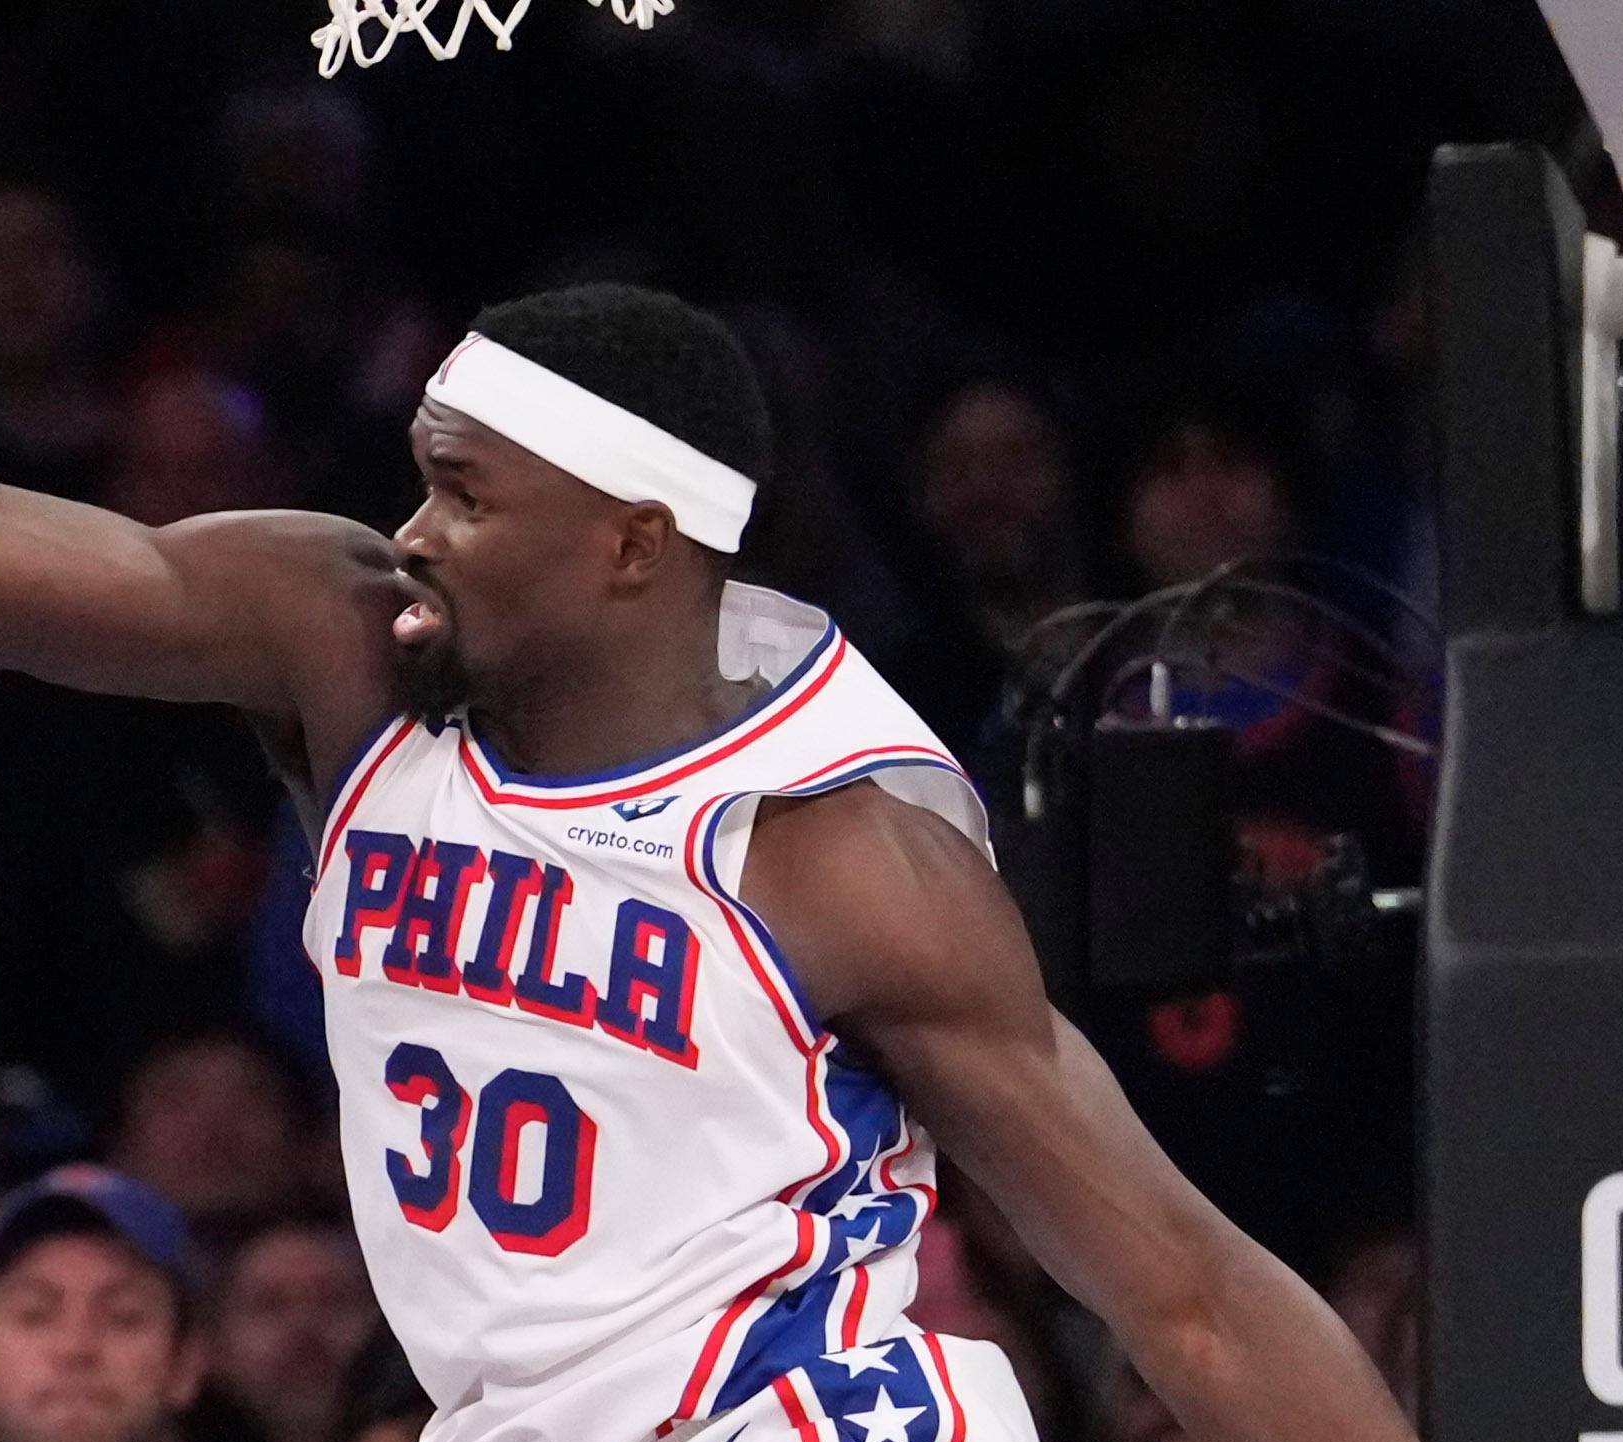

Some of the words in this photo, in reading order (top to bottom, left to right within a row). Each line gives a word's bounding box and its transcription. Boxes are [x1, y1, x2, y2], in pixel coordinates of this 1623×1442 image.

[337, 832, 698, 1069] PHILA
[567, 826, 674, 859] crypto.com
[384, 1042, 598, 1258] 30
